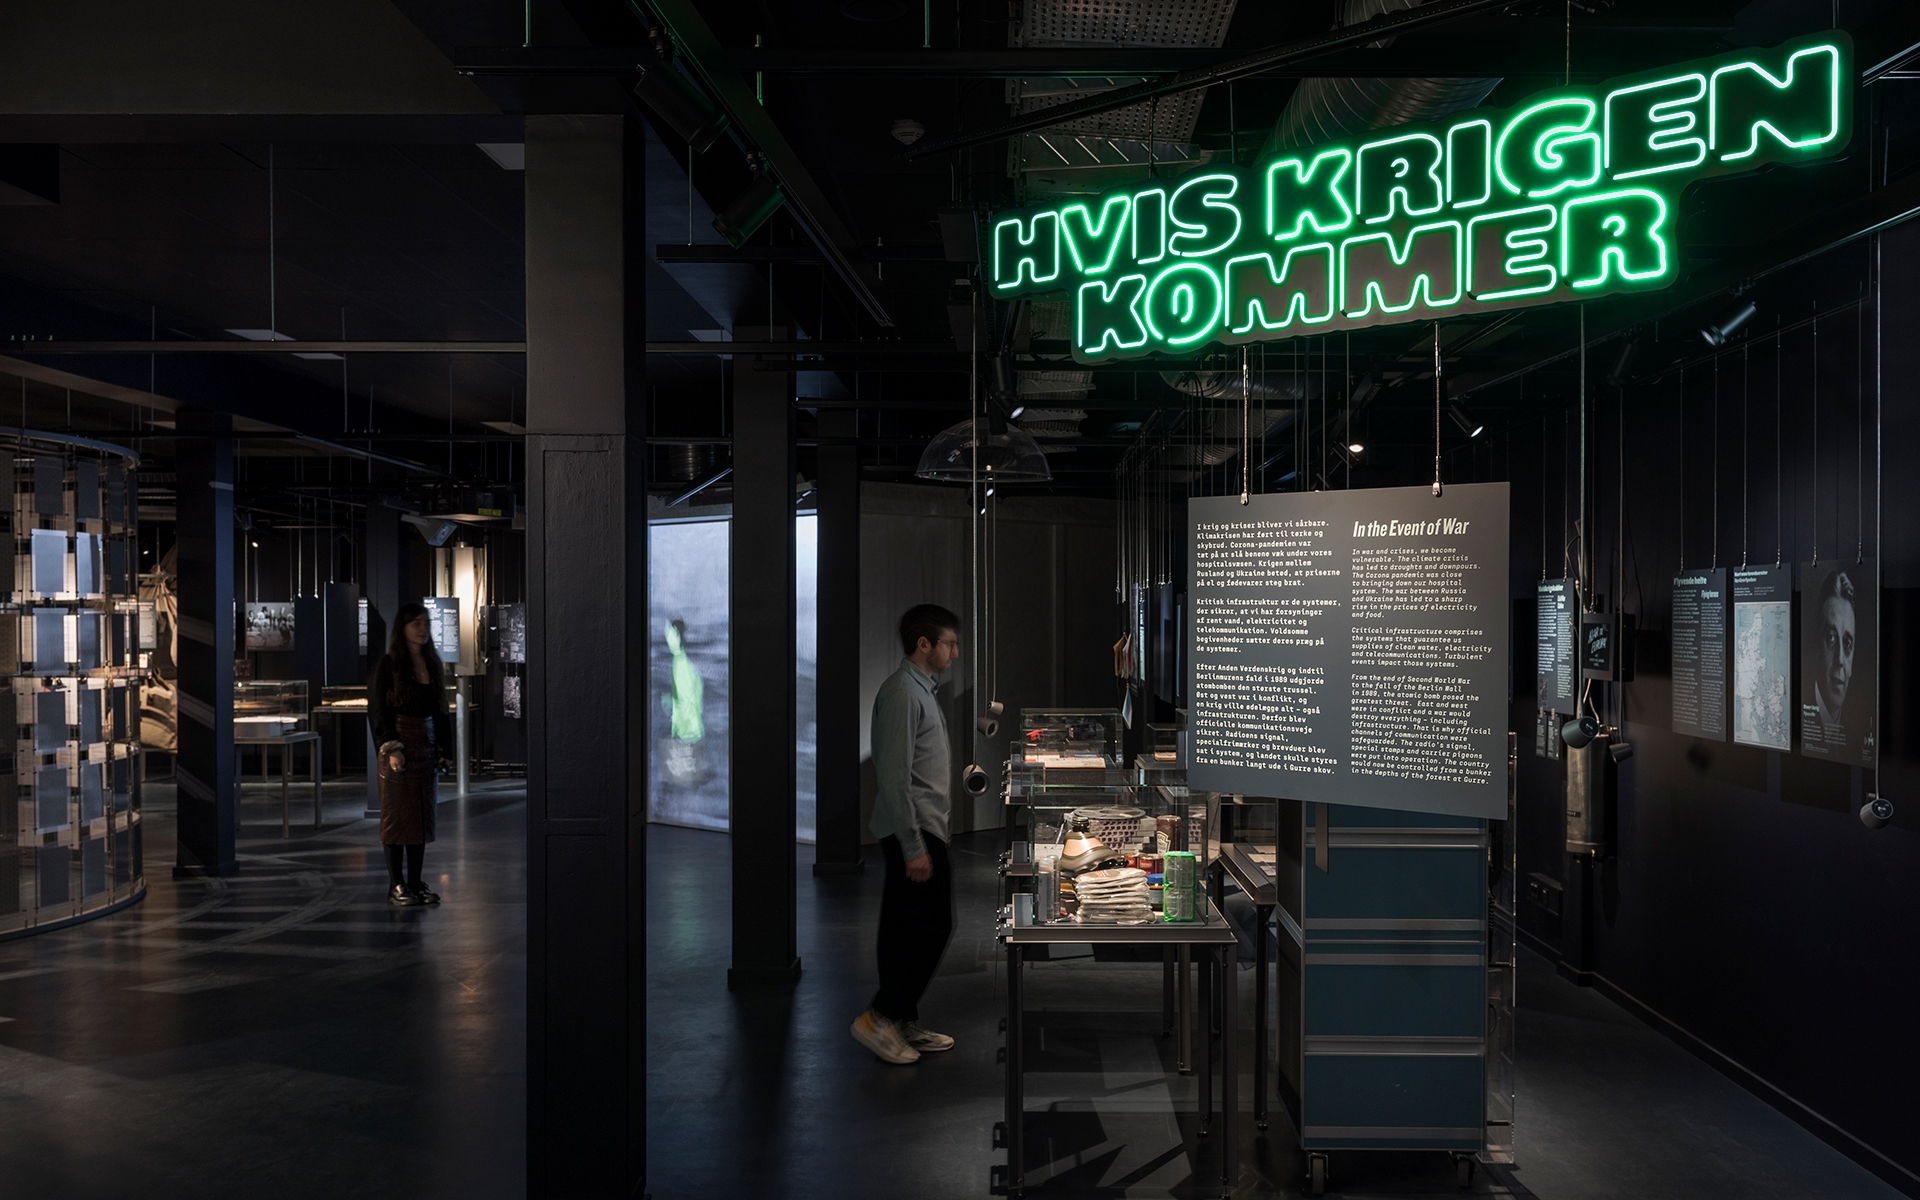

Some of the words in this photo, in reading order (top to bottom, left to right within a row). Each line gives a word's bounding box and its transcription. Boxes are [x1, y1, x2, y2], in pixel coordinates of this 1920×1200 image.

[996, 175, 1240, 289] HVIS
[1268, 45, 1839, 239] KRIGEN
[1078, 190, 1666, 353] KOMMER
[1203, 523, 1219, 531] krig
[1353, 521, 1365, 537] In
[1367, 520, 1388, 536] the
[1389, 520, 1425, 536] Event
[1426, 518, 1442, 535] of
[1443, 518, 1470, 535] War
[1211, 551, 1219, 559] på
[1276, 608, 1322, 616] forsyninger
[1316, 638, 1324, 646] på
[1445, 645, 1492, 653] electricity
[1240, 666, 1285, 674] Verdenskrig
[1290, 677, 1324, 685] udgjorde
[1196, 719, 1235, 728] officielle
[1430, 717, 1467, 726] including
[1272, 744, 1306, 752] brevduer
[1256, 752, 1281, 760] landet
[1246, 760, 1266, 769] langt
